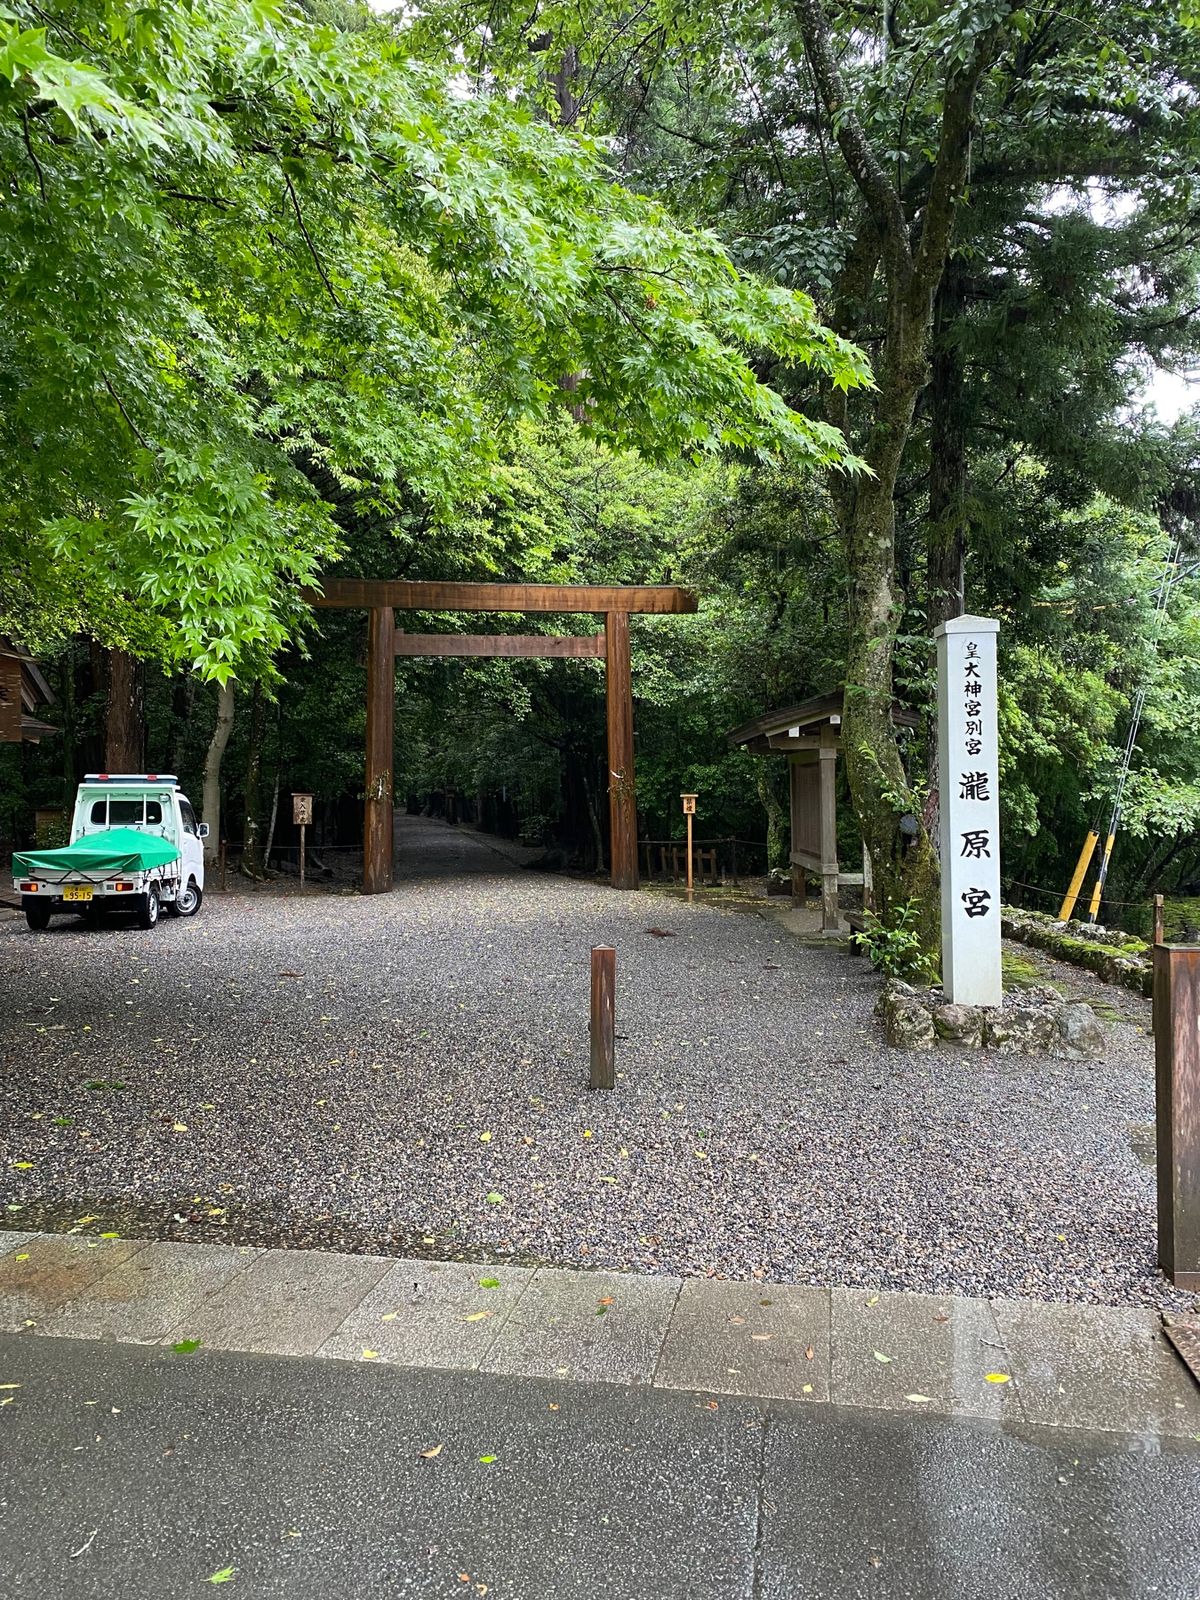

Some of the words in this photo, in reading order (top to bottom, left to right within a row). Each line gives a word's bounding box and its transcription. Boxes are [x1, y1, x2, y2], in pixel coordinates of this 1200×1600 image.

[964, 642, 982, 756] 皇大神宮別宮
[69, 891, 91, 900] 95-15
[958, 771, 991, 919] 瀧原宮
